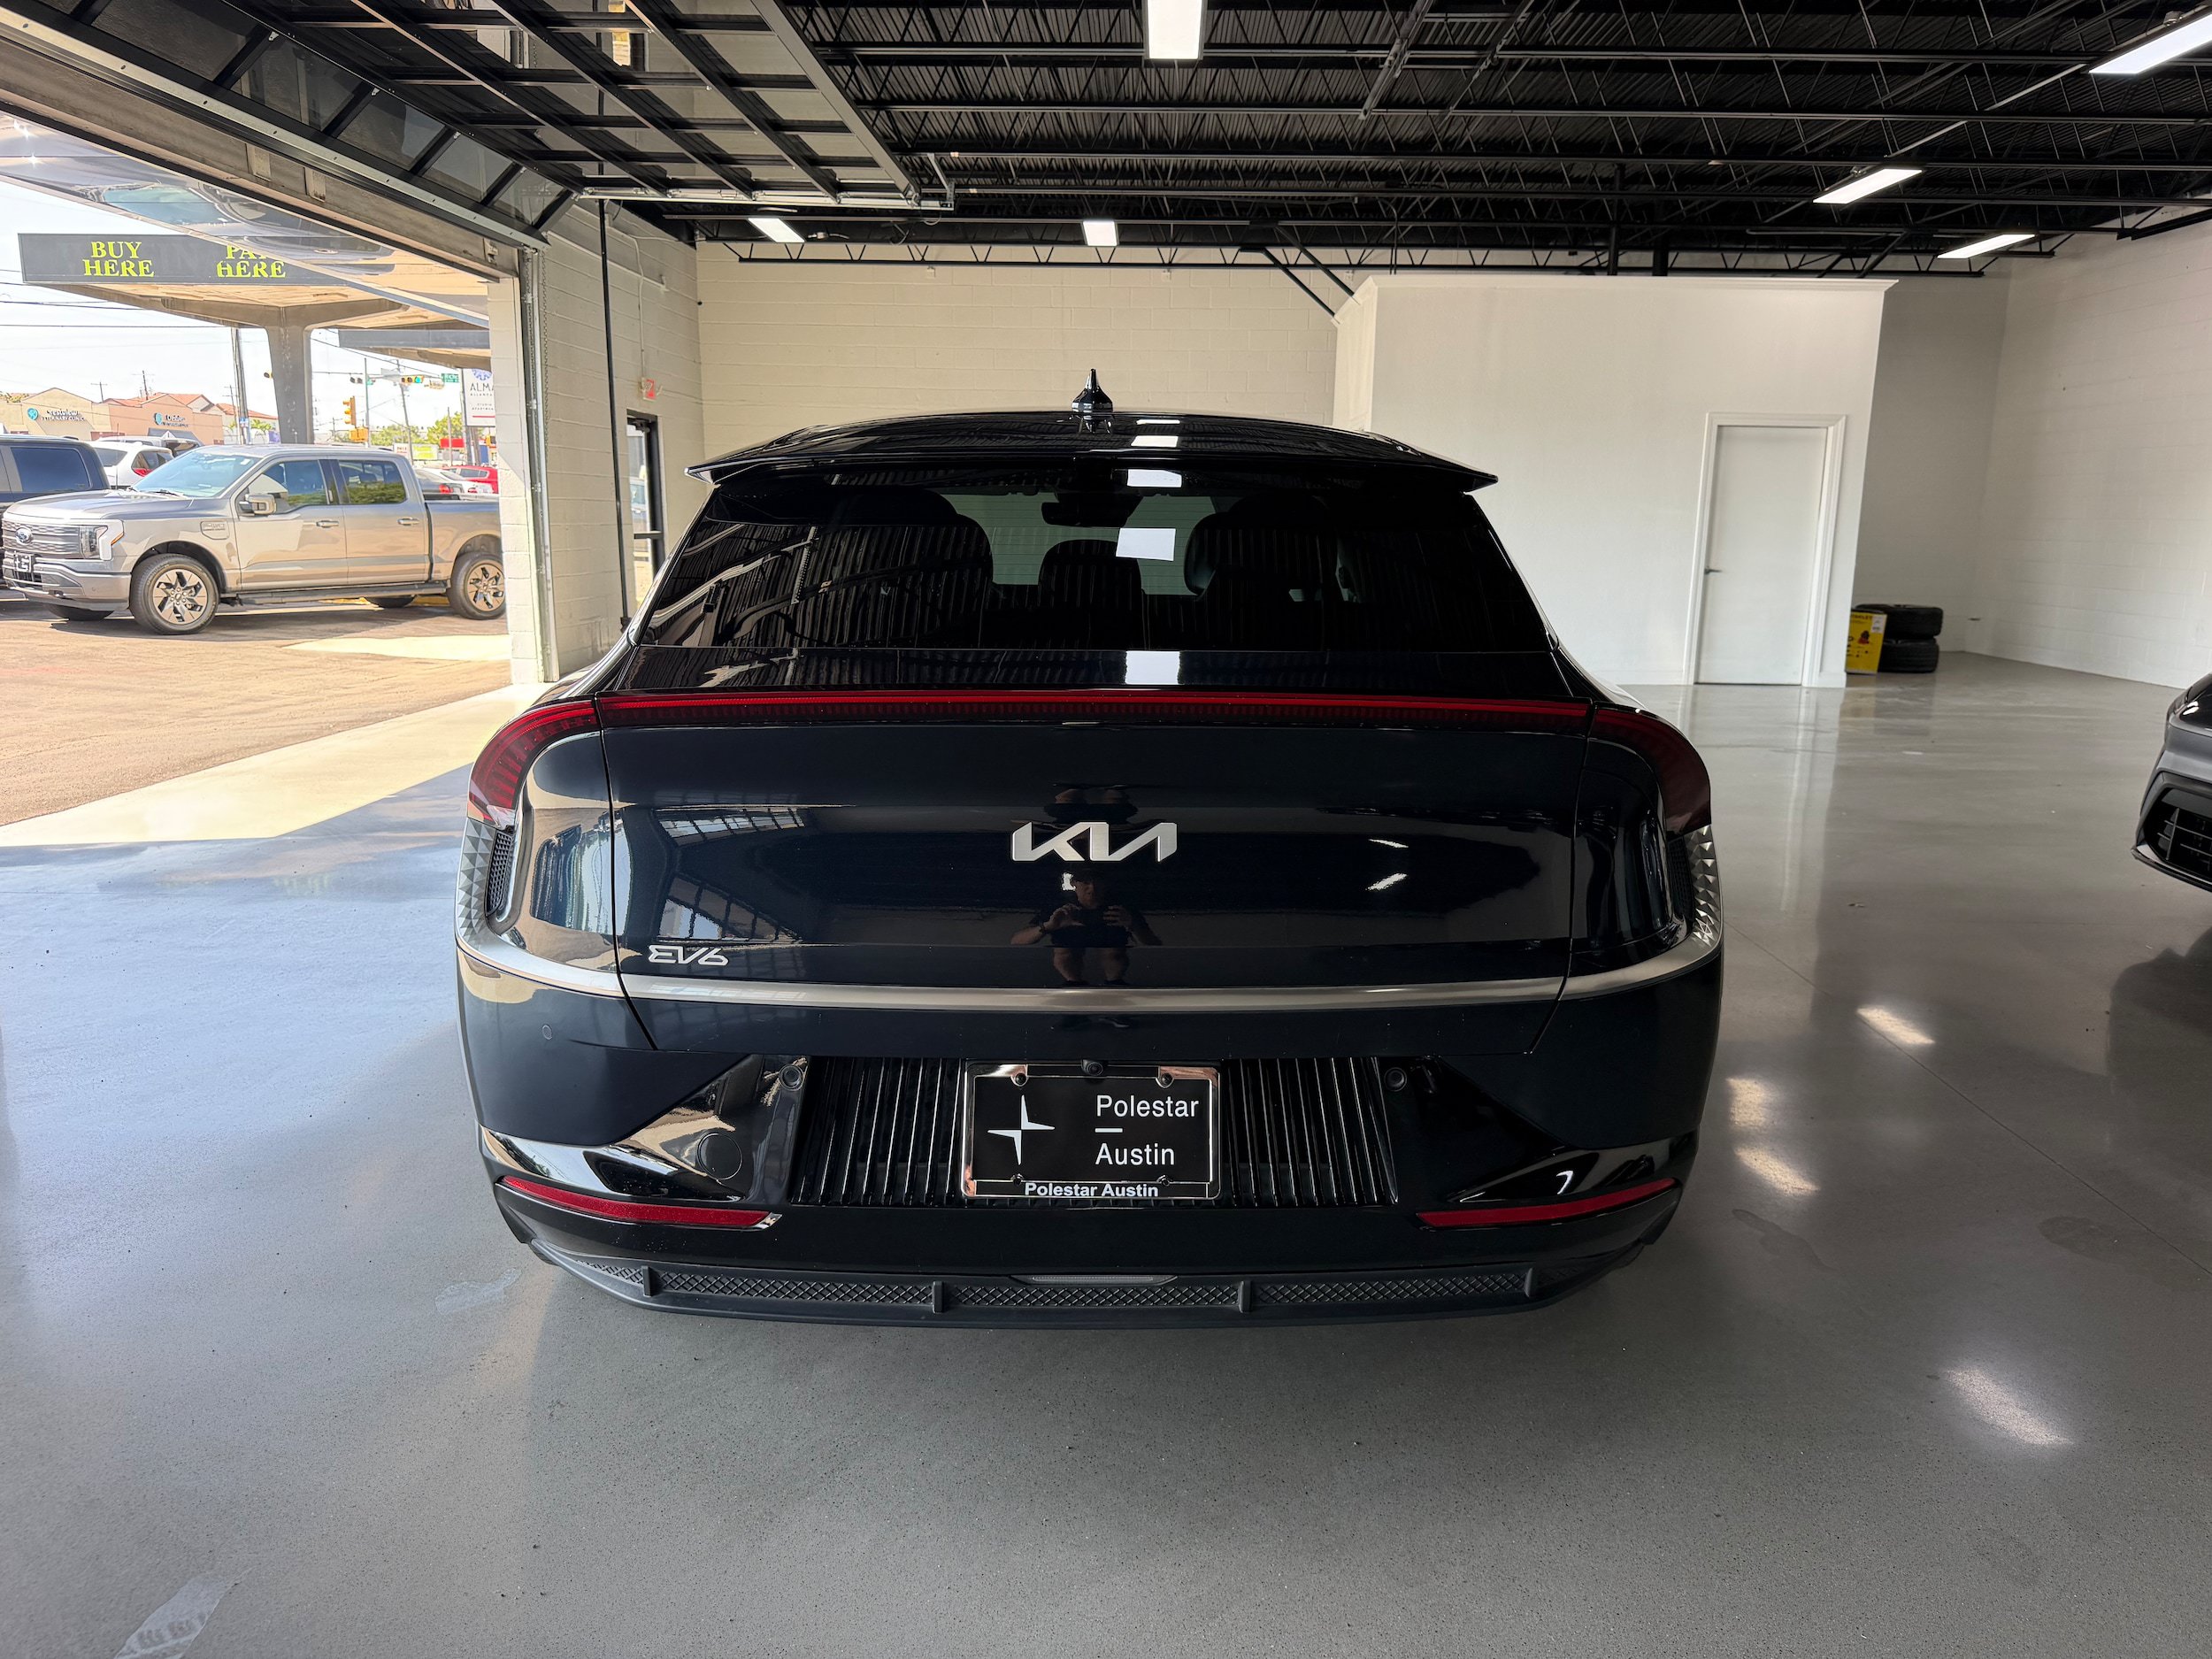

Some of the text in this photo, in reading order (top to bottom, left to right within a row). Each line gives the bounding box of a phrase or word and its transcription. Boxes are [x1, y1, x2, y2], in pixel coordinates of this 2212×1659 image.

[90, 241, 142, 259] BUY
[226, 244, 267, 259] PA
[81, 258, 155, 278] HERE
[216, 260, 286, 278] HERE
[1012, 821, 1178, 863] KIA
[648, 944, 729, 966] EV6
[1095, 1094, 1200, 1118] Polestar
[1094, 1142, 1175, 1165] Austin
[1025, 1183, 1159, 1198] Polestar Austin
